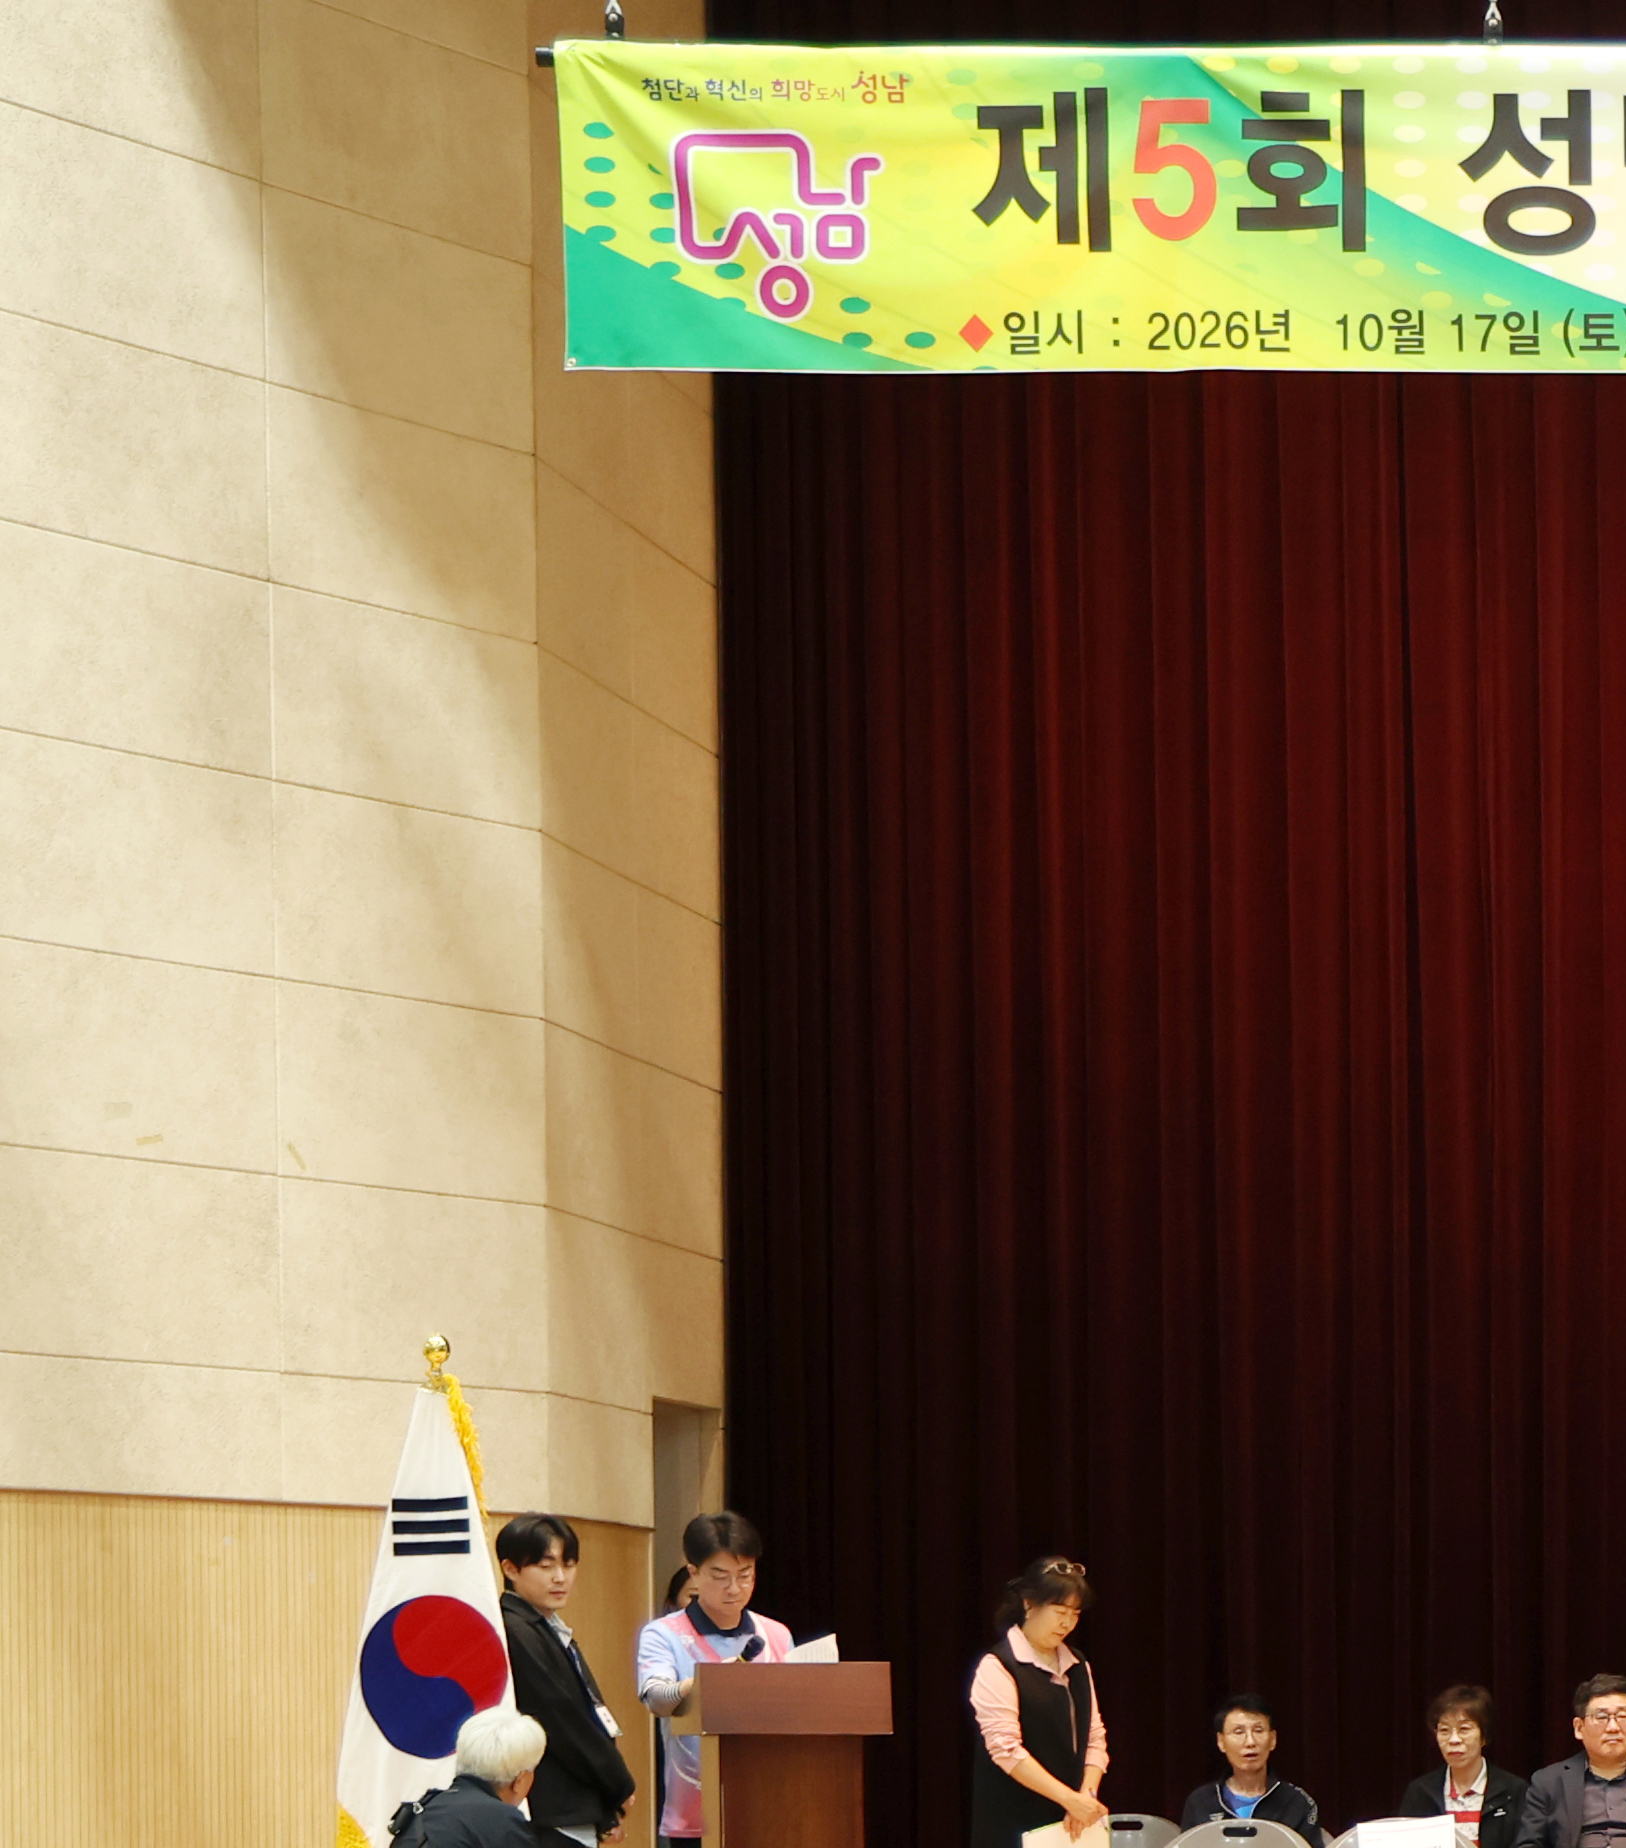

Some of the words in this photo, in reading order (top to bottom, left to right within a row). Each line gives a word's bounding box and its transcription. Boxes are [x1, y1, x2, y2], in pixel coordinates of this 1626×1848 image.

[642, 77, 700, 102] 첨단과
[704, 78, 763, 102] 혁신의
[771, 78, 845, 102] 희망도시
[851, 70, 910, 104] 성남
[973, 88, 1367, 253] 제5회
[1002, 309, 1085, 355] 일시
[1147, 308, 1292, 355] 2026년
[1334, 308, 1427, 355] 10월
[1449, 308, 1540, 355] 17일
